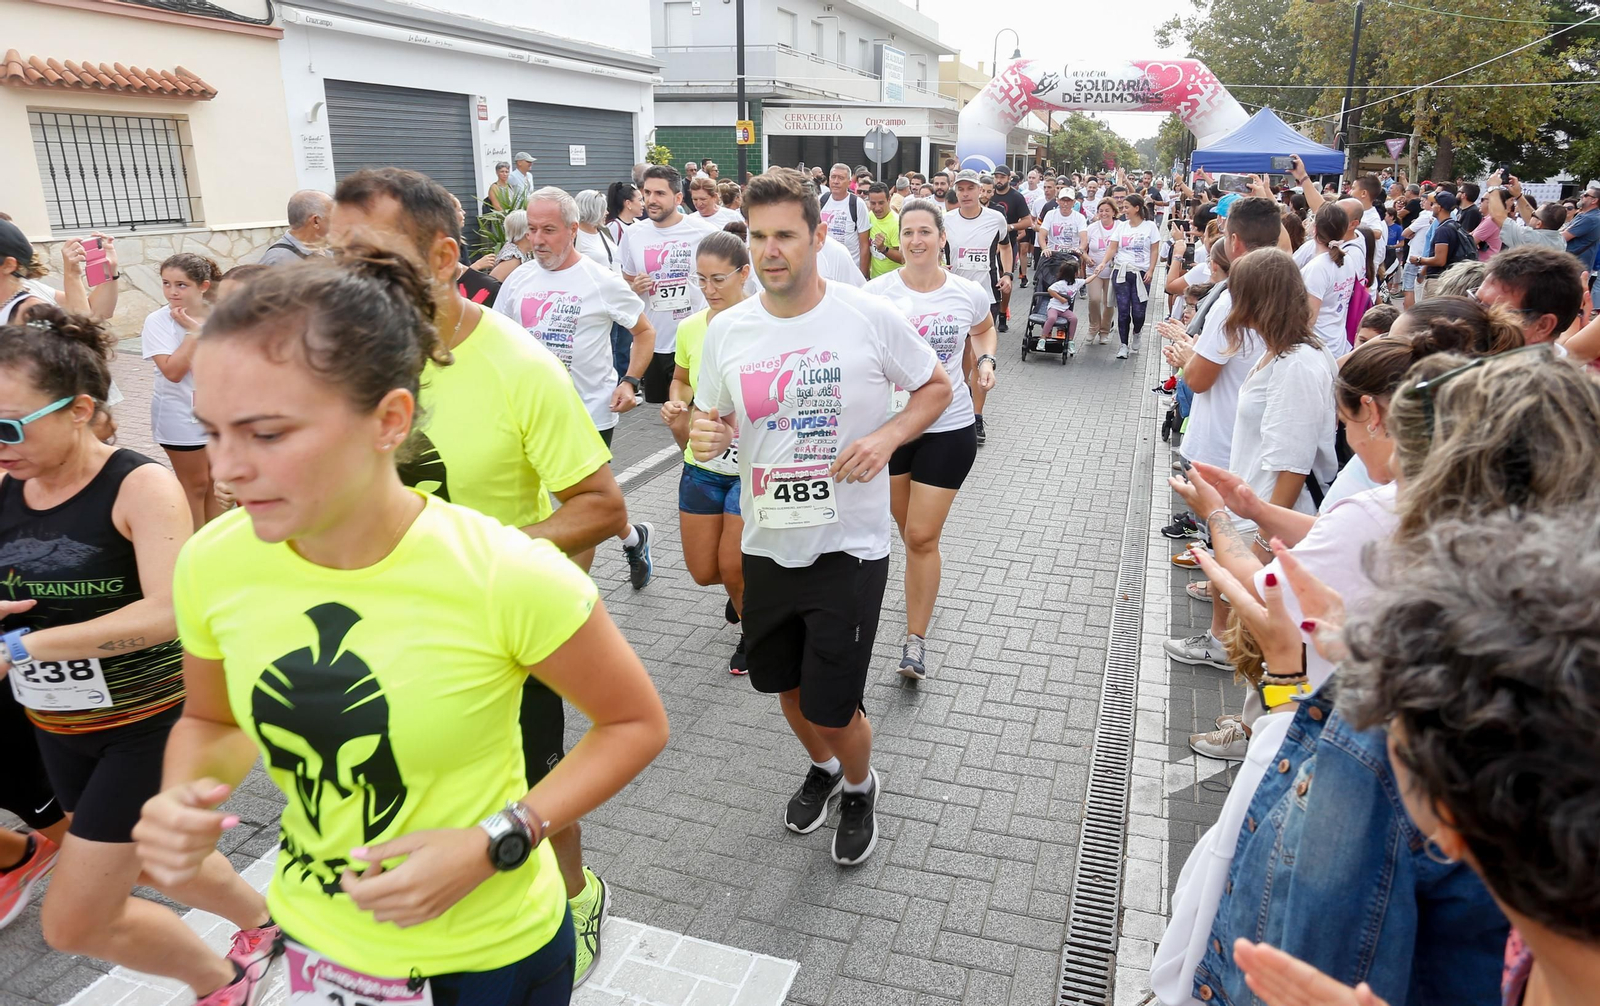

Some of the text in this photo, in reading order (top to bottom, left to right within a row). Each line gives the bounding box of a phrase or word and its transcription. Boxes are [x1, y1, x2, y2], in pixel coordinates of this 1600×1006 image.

[305, 15, 333, 27] Cruzcampo
[1064, 64, 1109, 79] Carrera
[1074, 79, 1151, 92] SOLIDARIA
[1062, 92, 1164, 104] DE PALMONES
[784, 113, 842, 123] CERVECERÍA
[865, 117, 906, 127] Cruzcampo
[784, 121, 843, 131] GIRALDILLO
[968, 254, 988, 263] 163
[655, 271, 689, 280] SONRISA
[660, 285, 686, 299] 377
[739, 358, 781, 373] valores
[798, 350, 840, 371] AMOR
[797, 399, 842, 408] FUERZA
[766, 415, 839, 432] SONRISA
[774, 480, 830, 503] 483
[26, 579, 125, 596] TRAINING
[24, 658, 95, 684] 238
